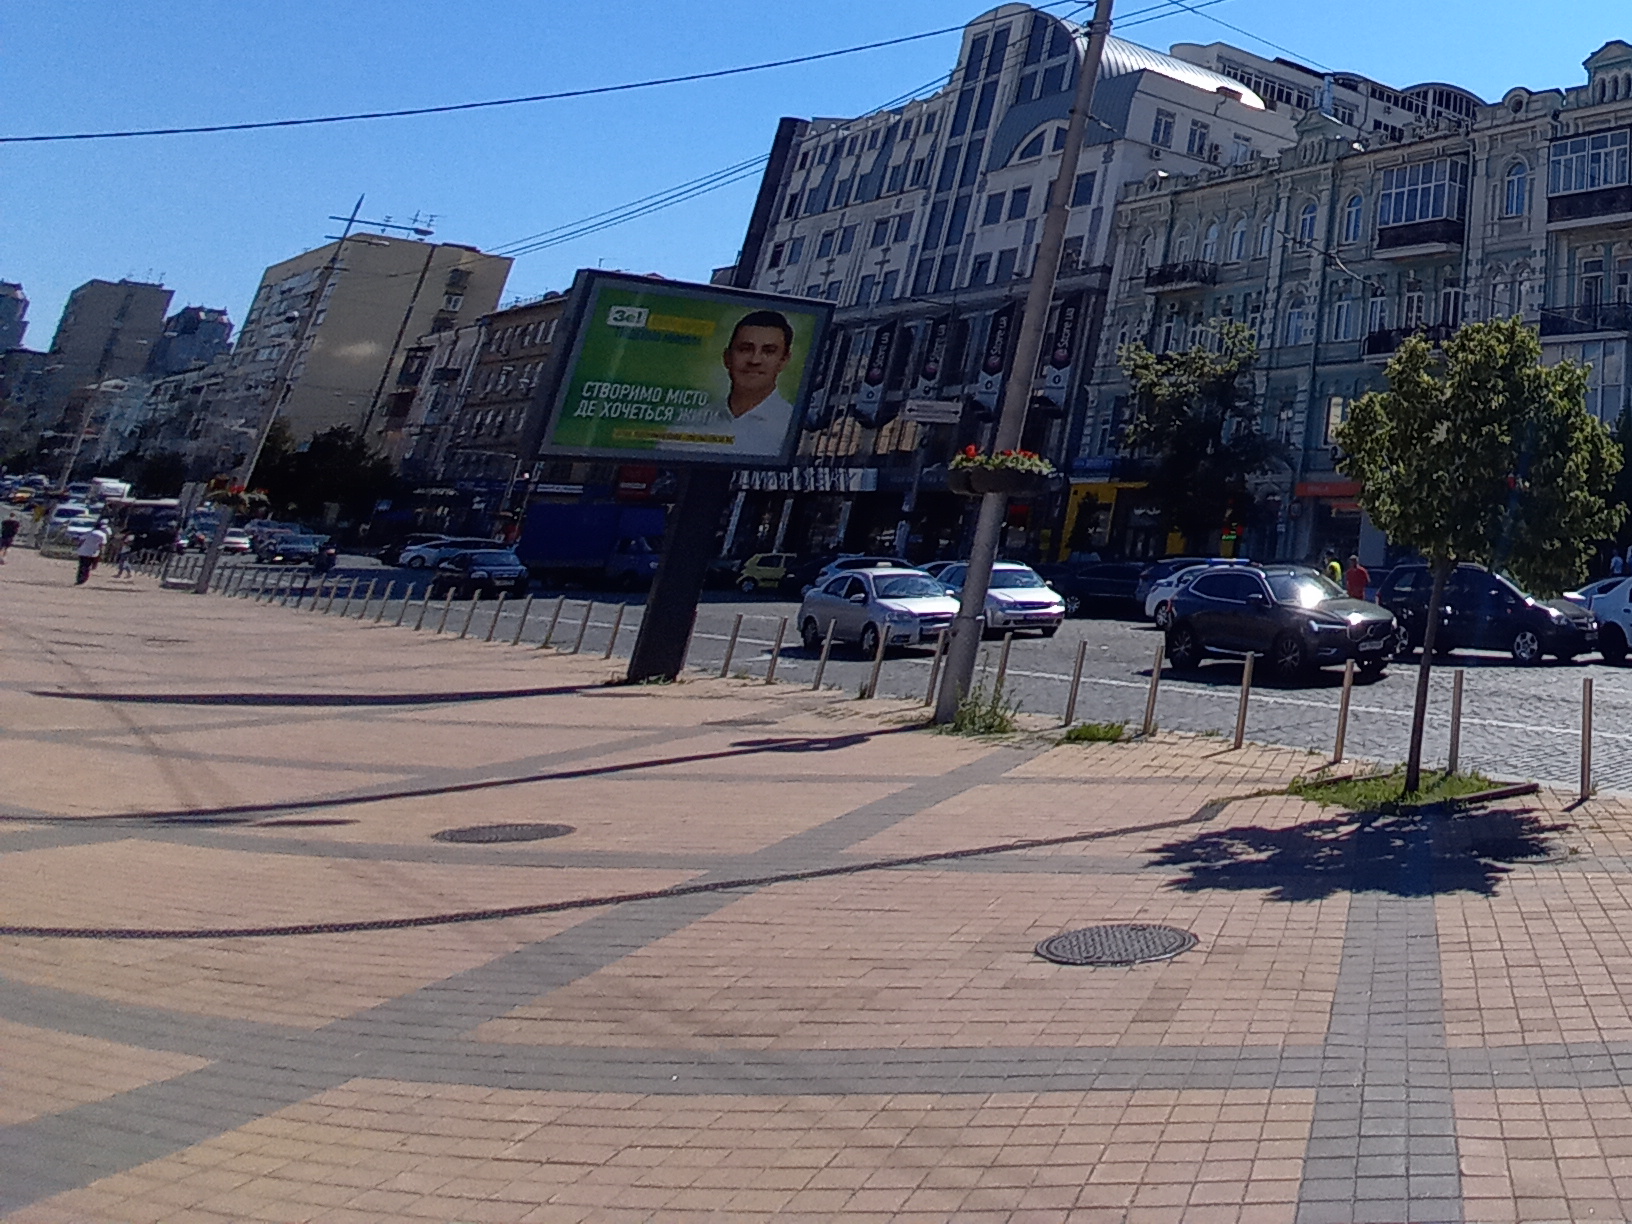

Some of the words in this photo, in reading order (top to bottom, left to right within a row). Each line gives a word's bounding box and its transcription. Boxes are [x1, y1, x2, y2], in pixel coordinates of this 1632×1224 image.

[582, 381, 662, 402] СТВОРИМО
[574, 400, 598, 418] ДЕ
[600, 401, 674, 422] ХОЧЕТЬСЯ
